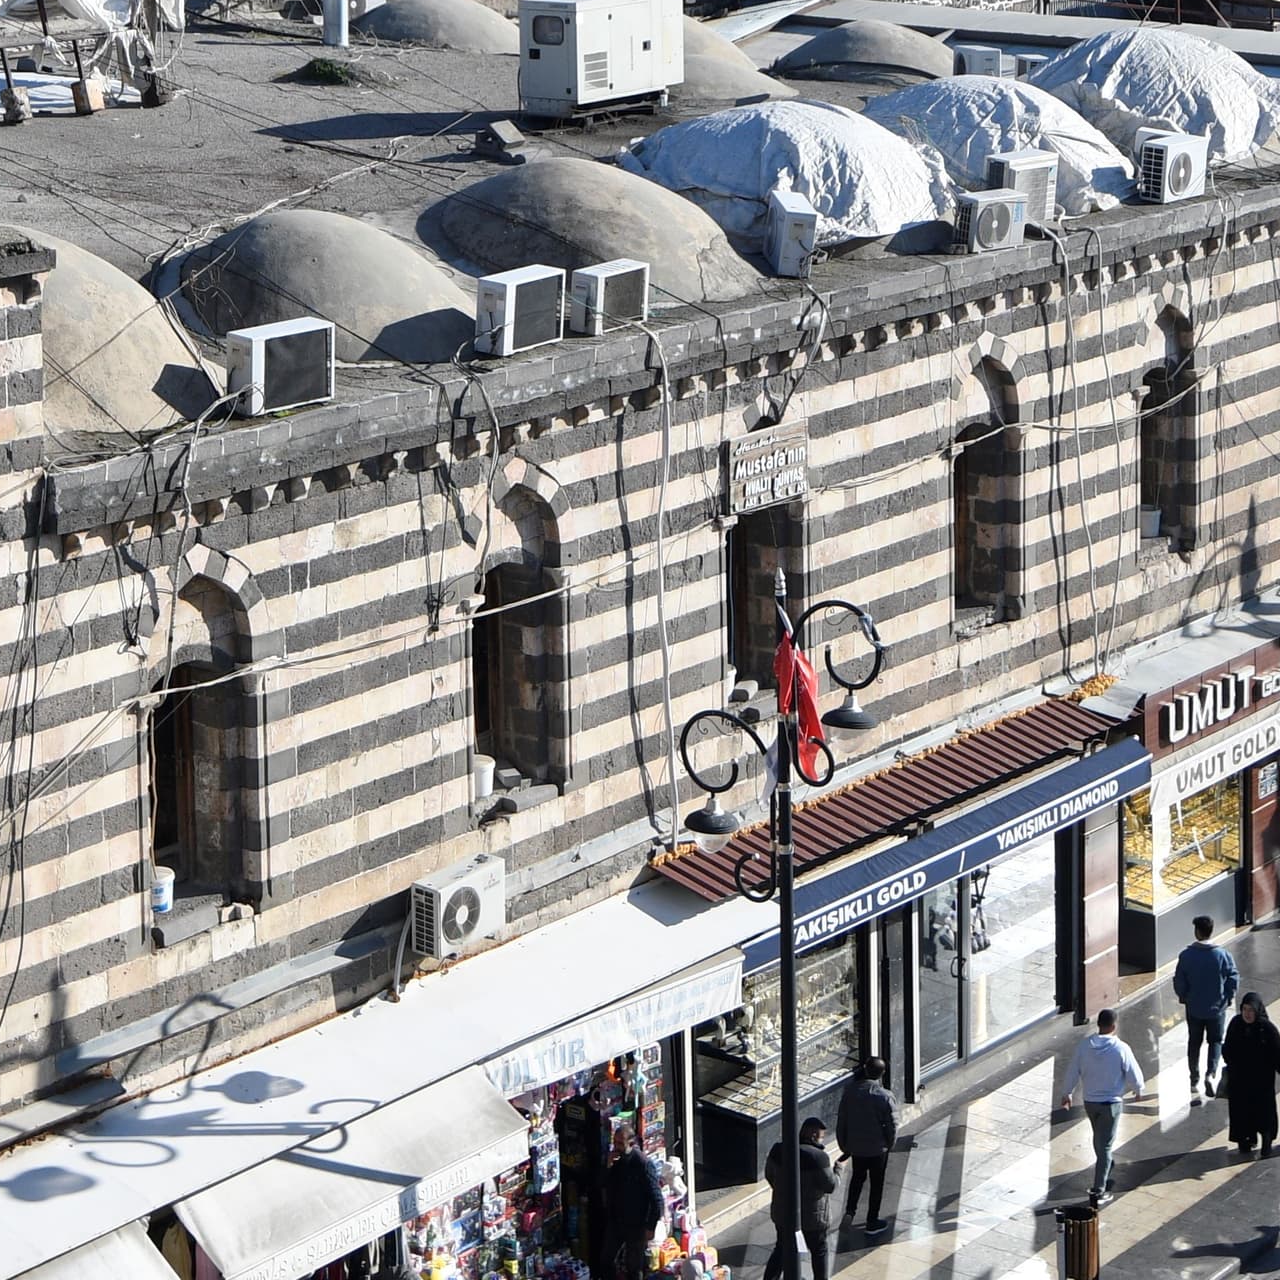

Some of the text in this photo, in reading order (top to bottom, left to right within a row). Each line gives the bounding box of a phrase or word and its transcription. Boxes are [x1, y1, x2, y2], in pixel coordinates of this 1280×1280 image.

[1167, 665, 1256, 743] UMUT
[1176, 751, 1226, 794] UMUT
[1232, 726, 1277, 766] GOLD
[794, 894, 873, 946] AKIŞIKLI
[877, 871, 927, 906] GOLD
[996, 807, 1059, 851] YAKIŞIKLI
[1060, 780, 1119, 820] DIAMOND
